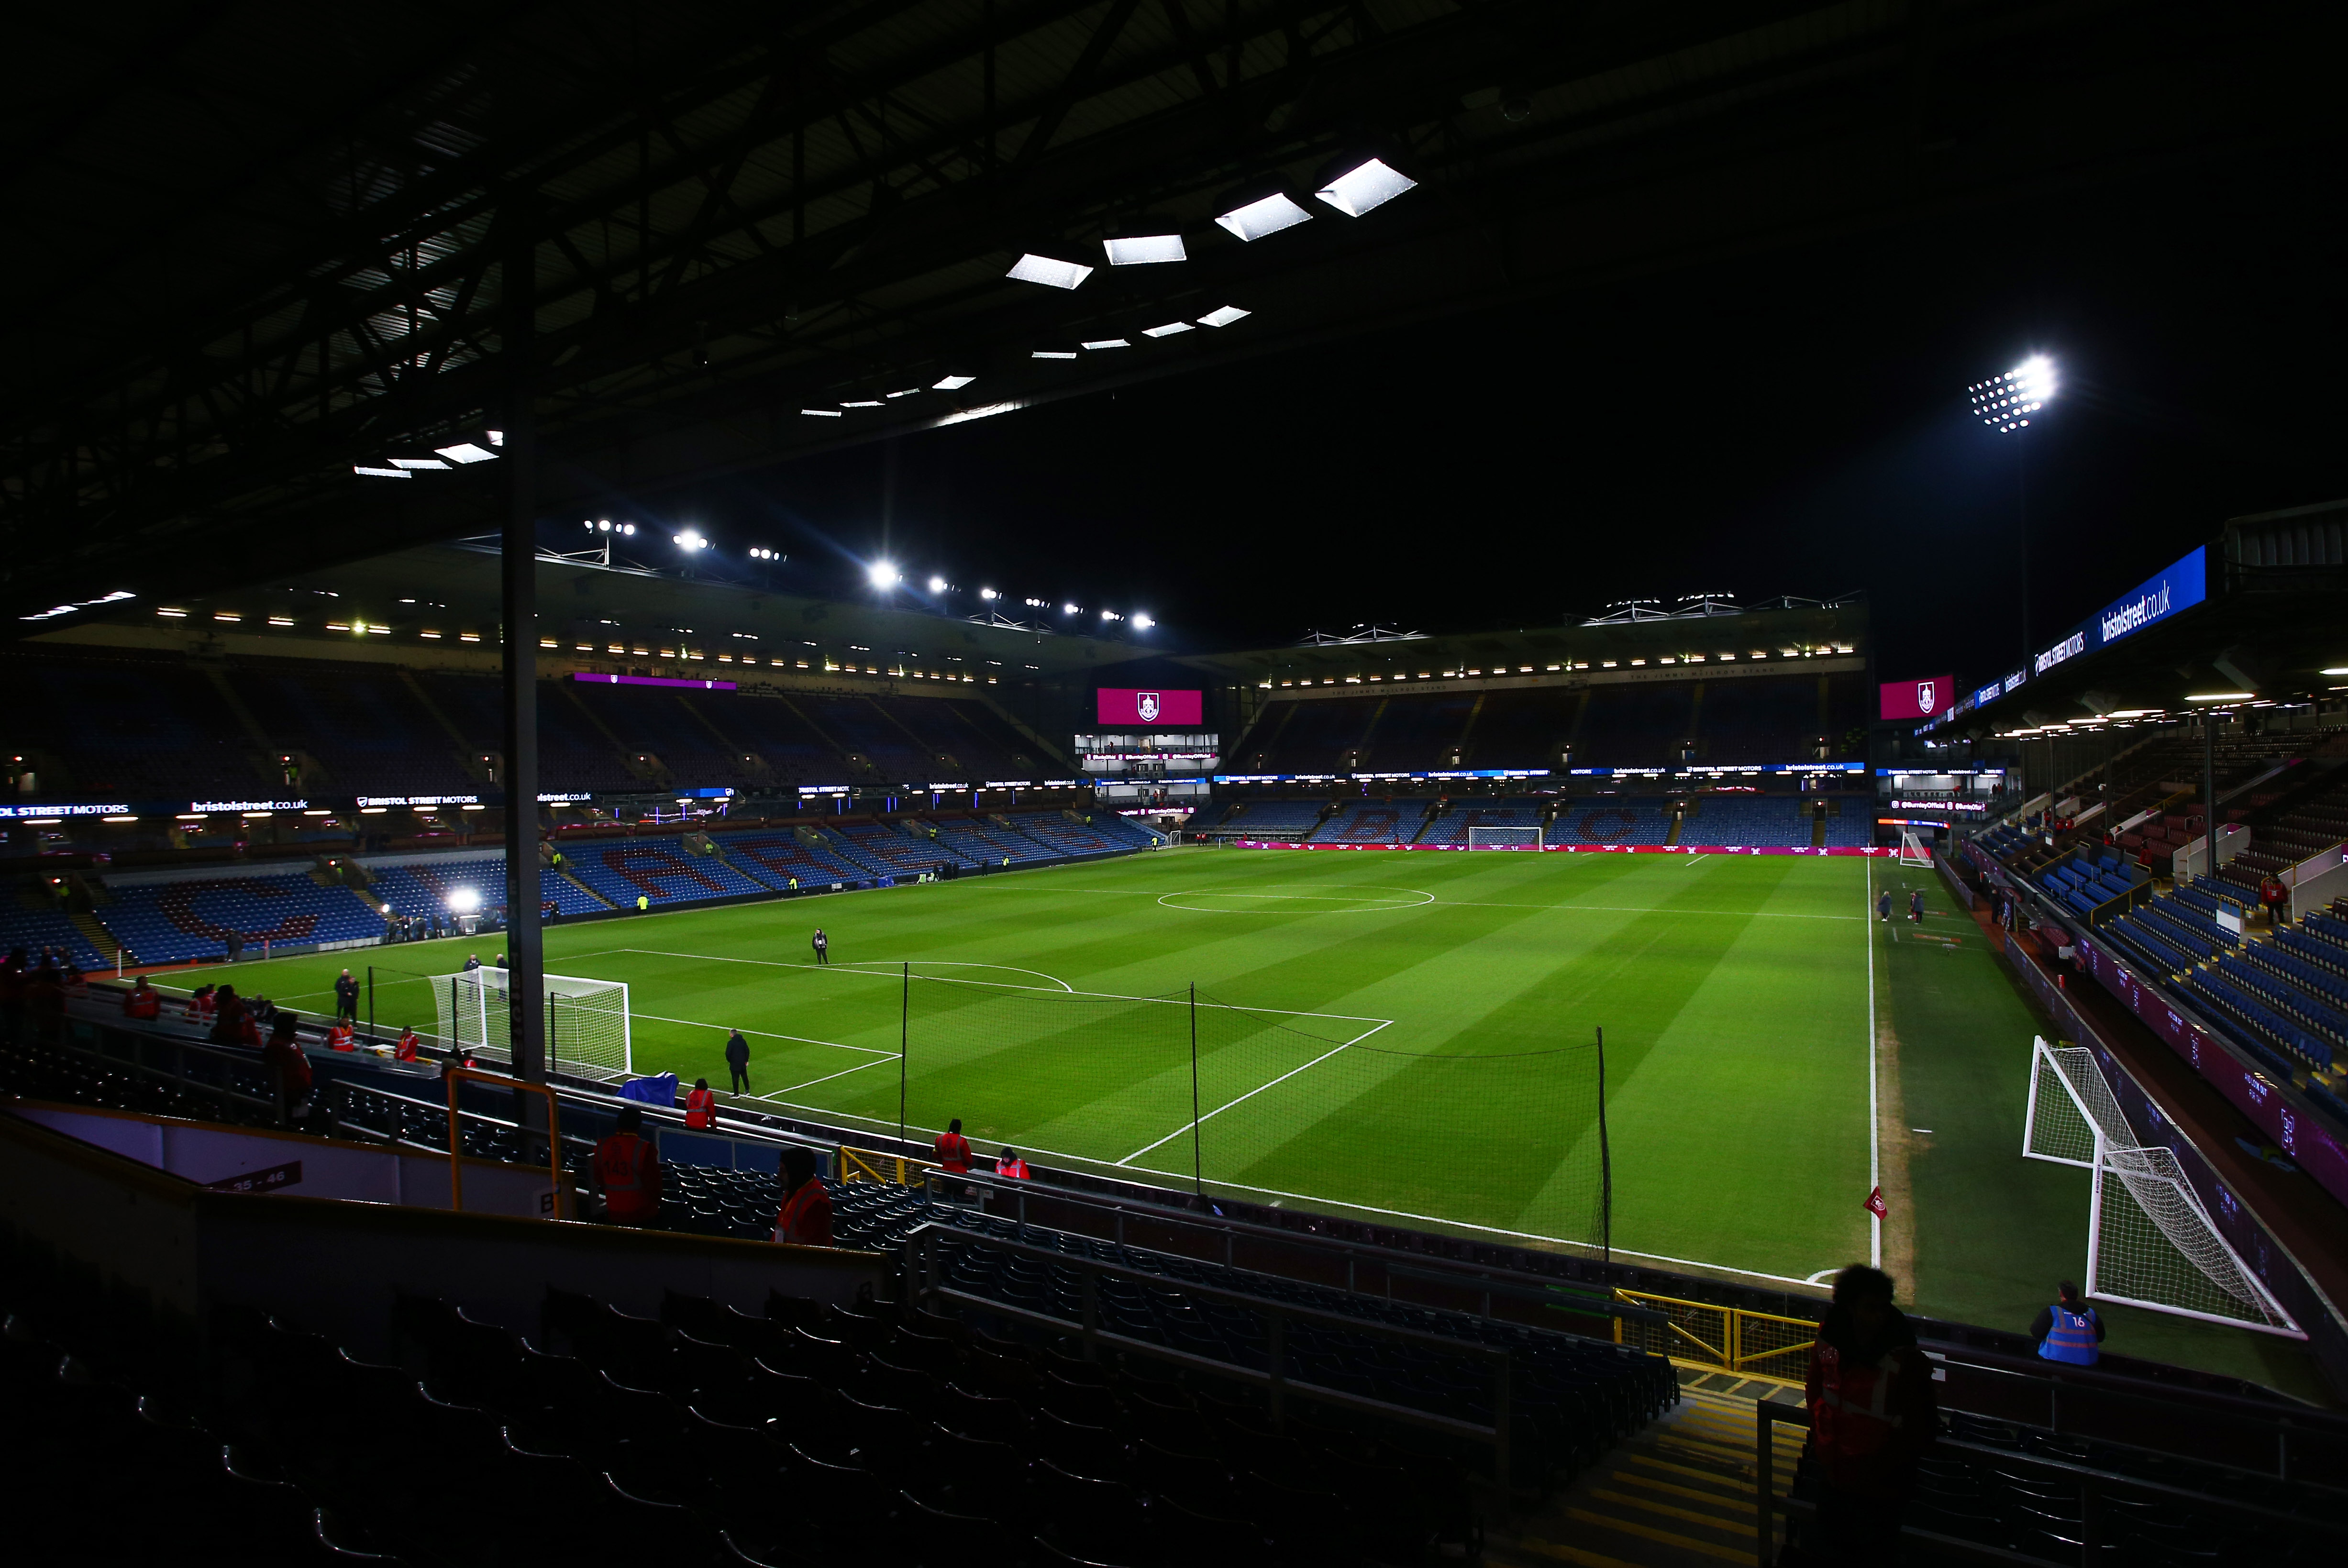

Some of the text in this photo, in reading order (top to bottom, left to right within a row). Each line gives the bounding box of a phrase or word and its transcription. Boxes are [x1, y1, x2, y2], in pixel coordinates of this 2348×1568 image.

[2103, 580, 2170, 641] bristolstreet.co.uk
[2038, 631, 2083, 674] BRISTOL STREET MOTORS
[1428, 770, 1473, 778] bristolstreet.co.uk
[192, 799, 308, 812] bristolstreet.co.uk
[367, 795, 477, 806] BRISTOL STREET MOTORS
[18, 806, 72, 816] STREET
[72, 805, 129, 814] MOTORS
[266, 1171, 286, 1183] 46
[542, 1194, 554, 1214] B
[2072, 1317, 2085, 1327] 16
